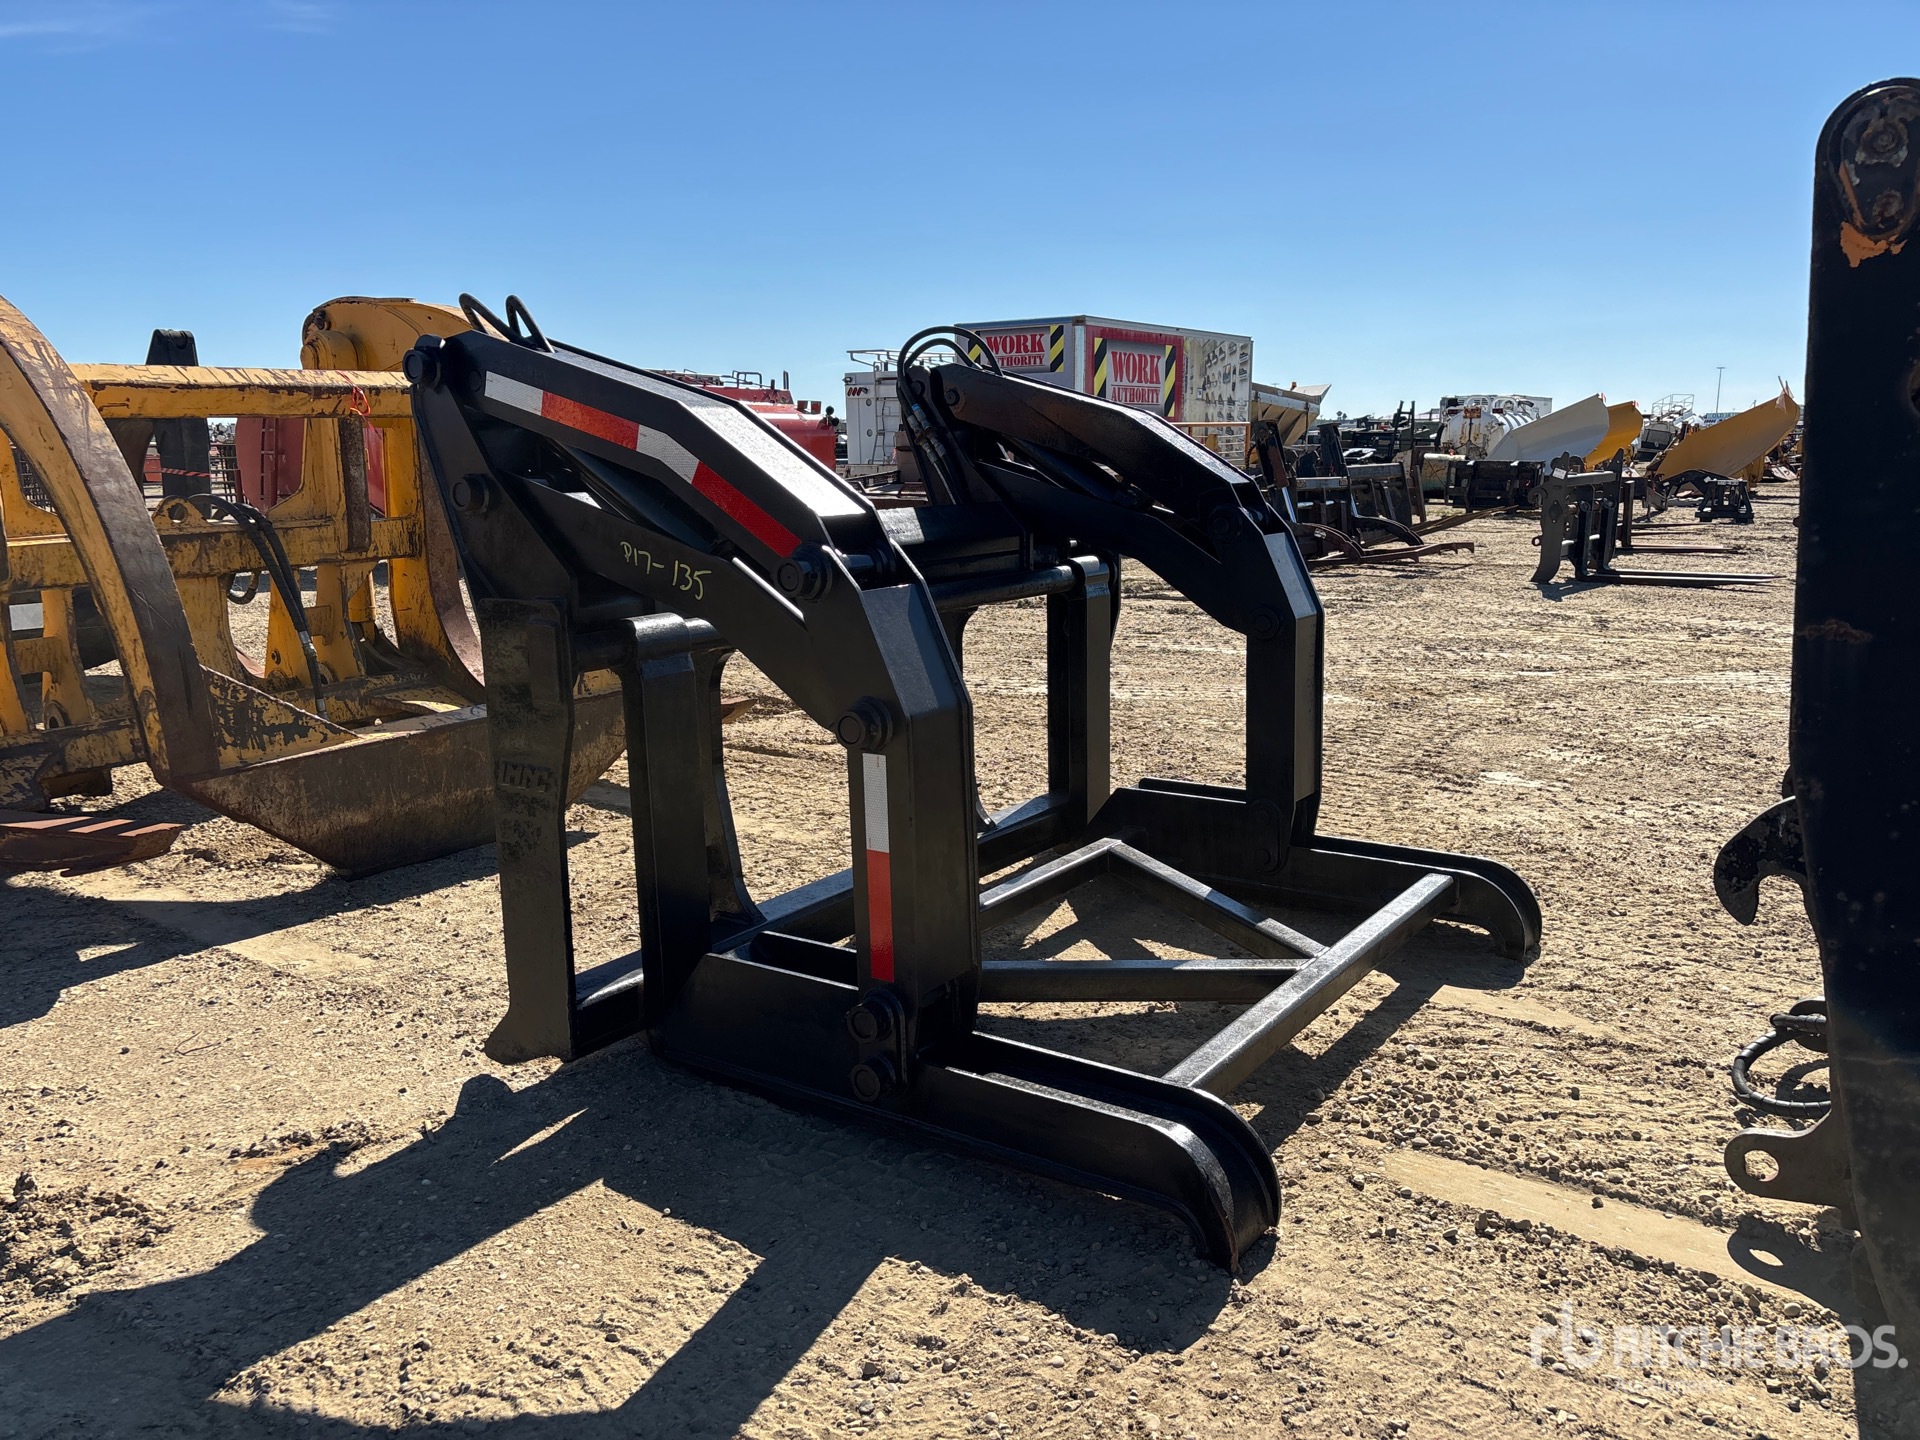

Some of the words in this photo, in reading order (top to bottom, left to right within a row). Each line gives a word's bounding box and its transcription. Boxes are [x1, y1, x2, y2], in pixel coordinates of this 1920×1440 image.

[985, 334, 1045, 354] WORK
[997, 355, 1045, 366] THORITY
[1111, 351, 1161, 385] WORK
[1111, 387, 1161, 404] AUTHORITY
